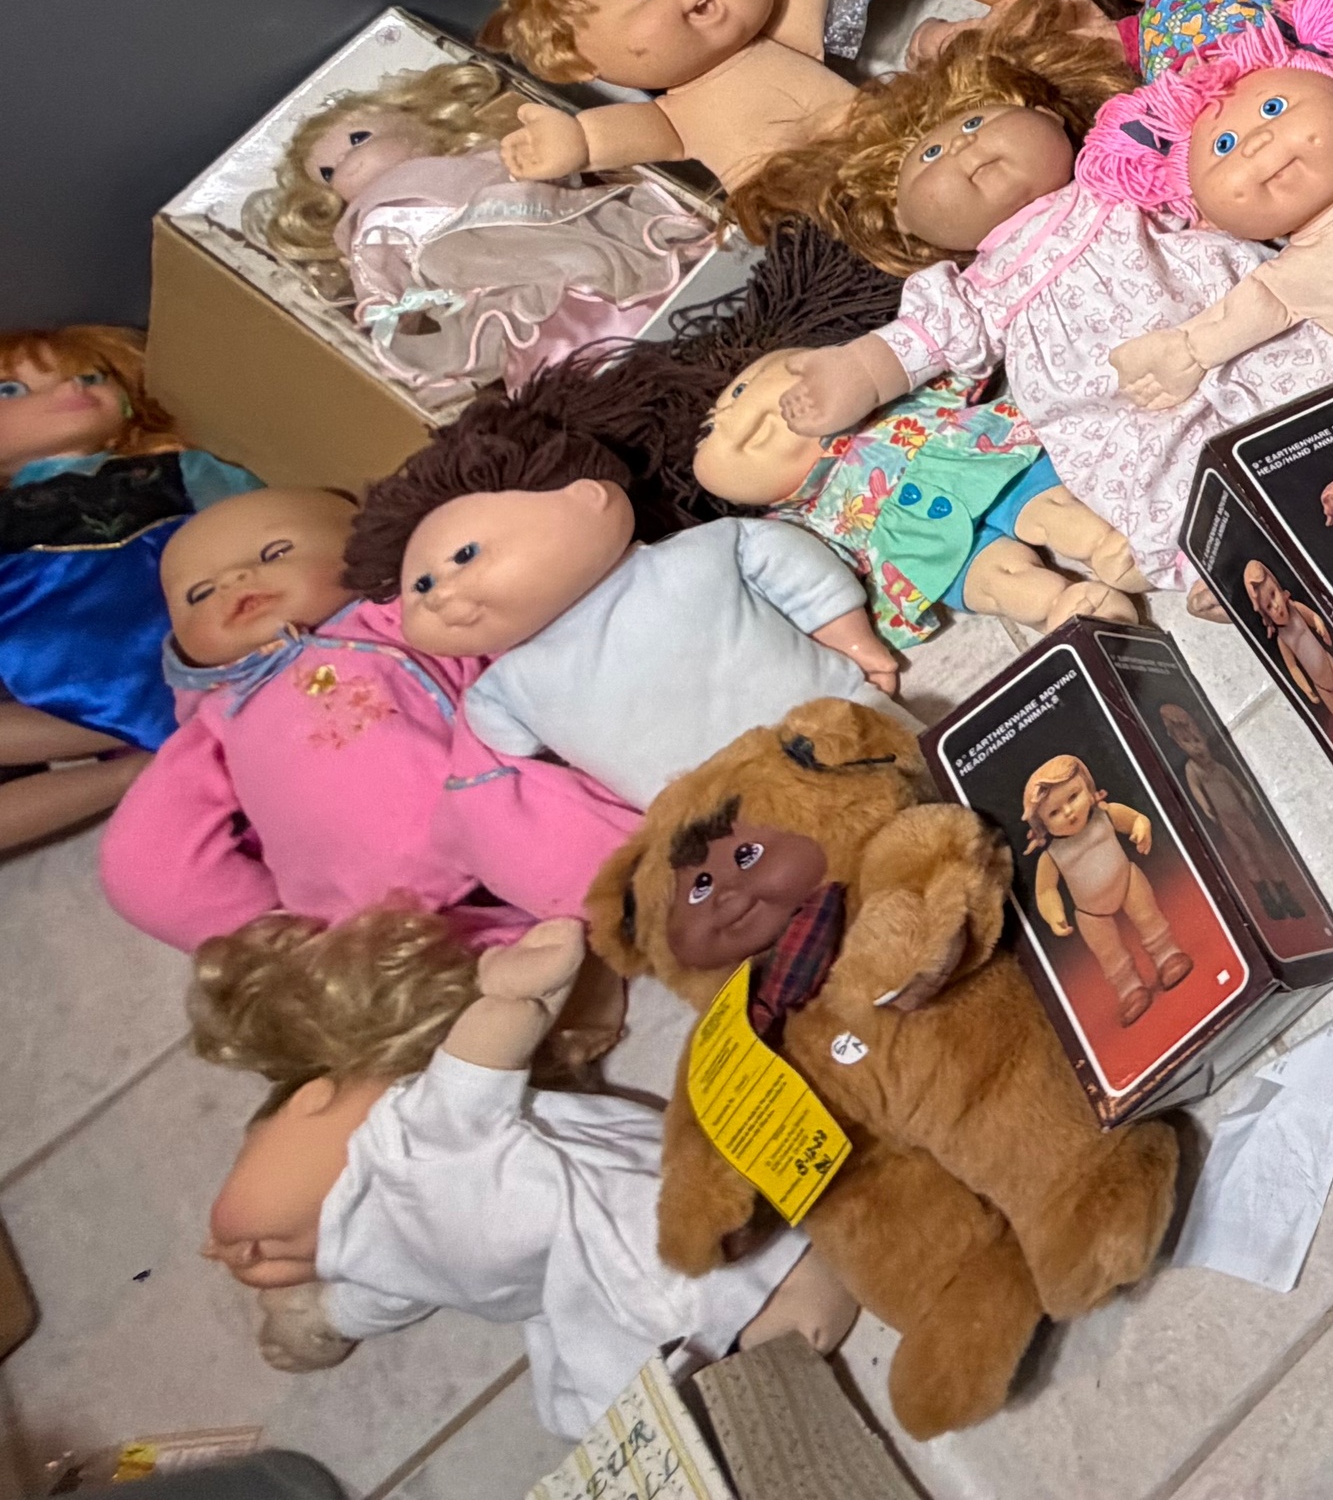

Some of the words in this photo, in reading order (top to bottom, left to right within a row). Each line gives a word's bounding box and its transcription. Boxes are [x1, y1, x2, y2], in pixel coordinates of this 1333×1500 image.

[1256, 447, 1311, 477] HEAD/HAND
[1266, 430, 1332, 464] EARTHENWARE
[959, 728, 1017, 777] HEAD/HAND
[1018, 694, 1060, 732] ANIMALS
[968, 699, 1039, 758] EARTHENWARE
[1039, 669, 1078, 702] MOVING
